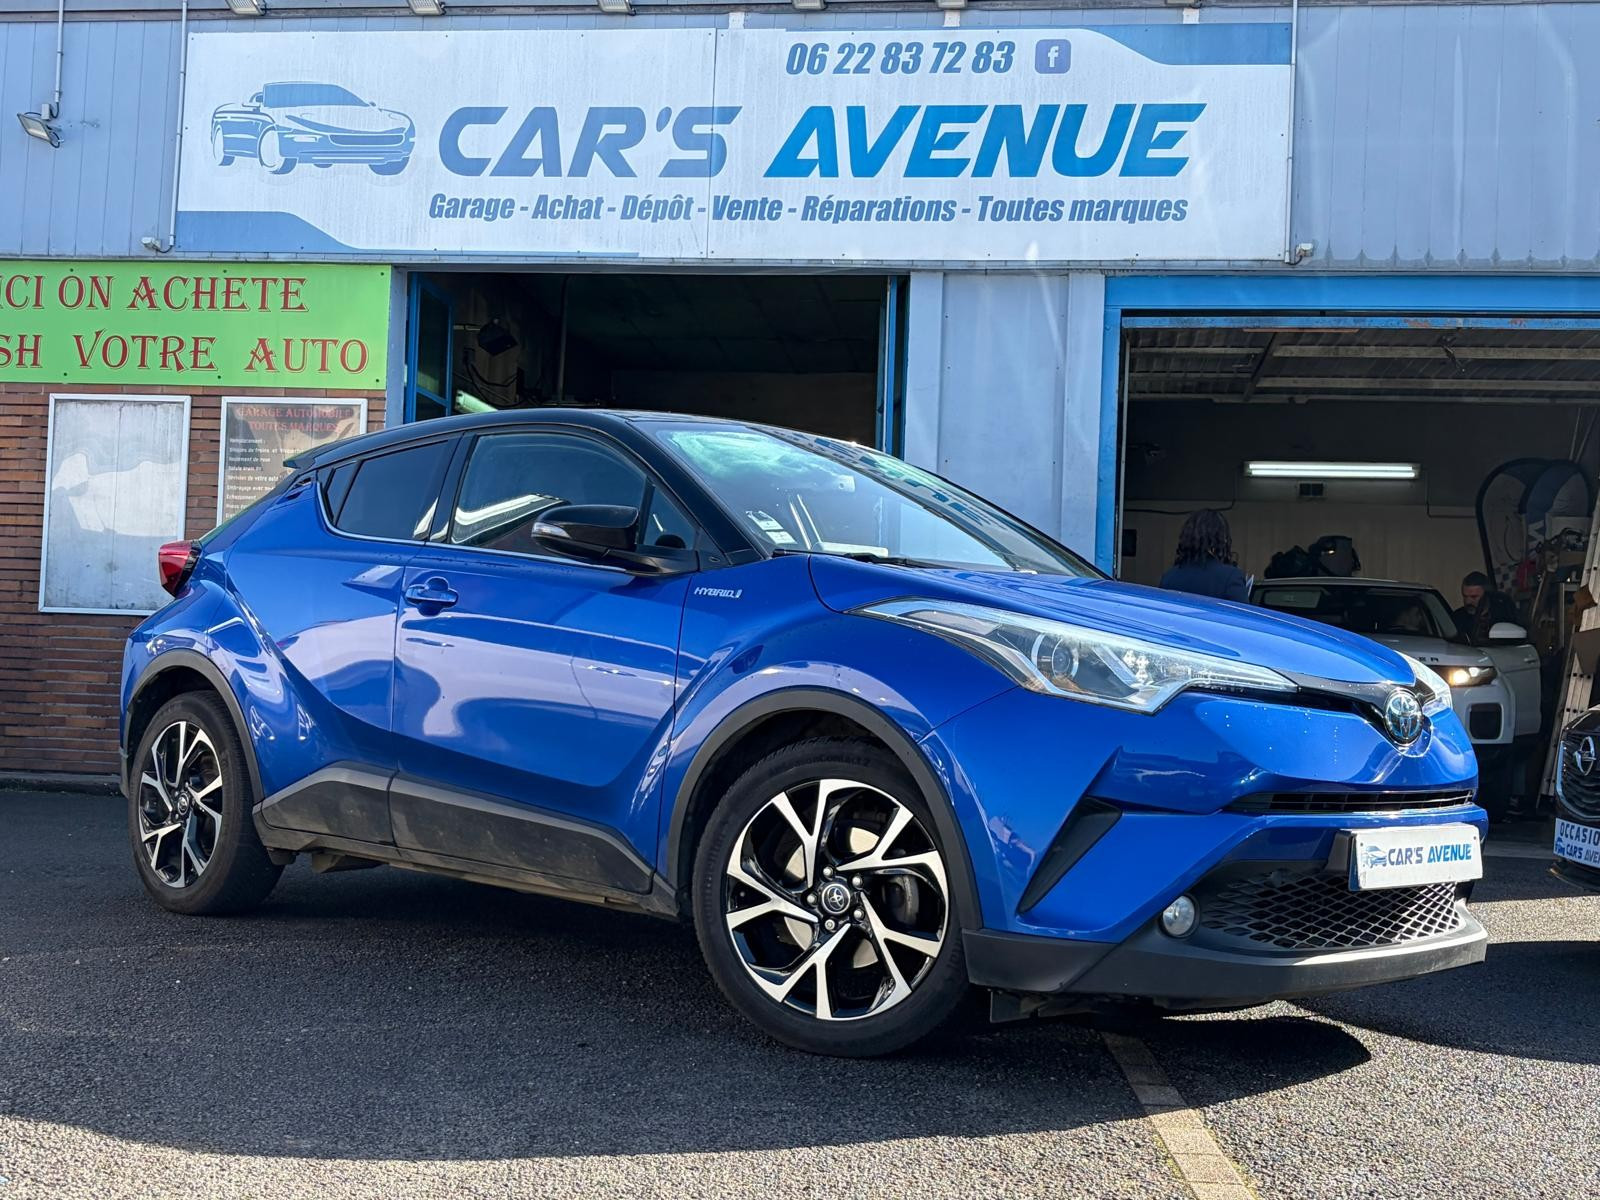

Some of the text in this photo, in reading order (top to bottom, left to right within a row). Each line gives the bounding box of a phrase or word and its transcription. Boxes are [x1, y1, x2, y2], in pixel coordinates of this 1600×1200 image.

[786, 41, 1016, 75] 06 22 83 72 83
[438, 103, 1207, 178] CAR'S AVENUE
[429, 193, 515, 222] Garage
[531, 194, 604, 219] Achat
[620, 194, 694, 223] Dépôt
[712, 195, 783, 221] Vente
[801, 195, 956, 224] Réparations
[978, 195, 1063, 222] Toutes
[1069, 199, 1188, 224] marques
[58, 275, 116, 310] ON
[126, 276, 309, 312] ACHETE
[72, 328, 218, 373] VOTRE
[244, 337, 369, 374] AUTO
[694, 586, 735, 598] HYBRID
[1388, 843, 1473, 866] CAR'S AVENUE
